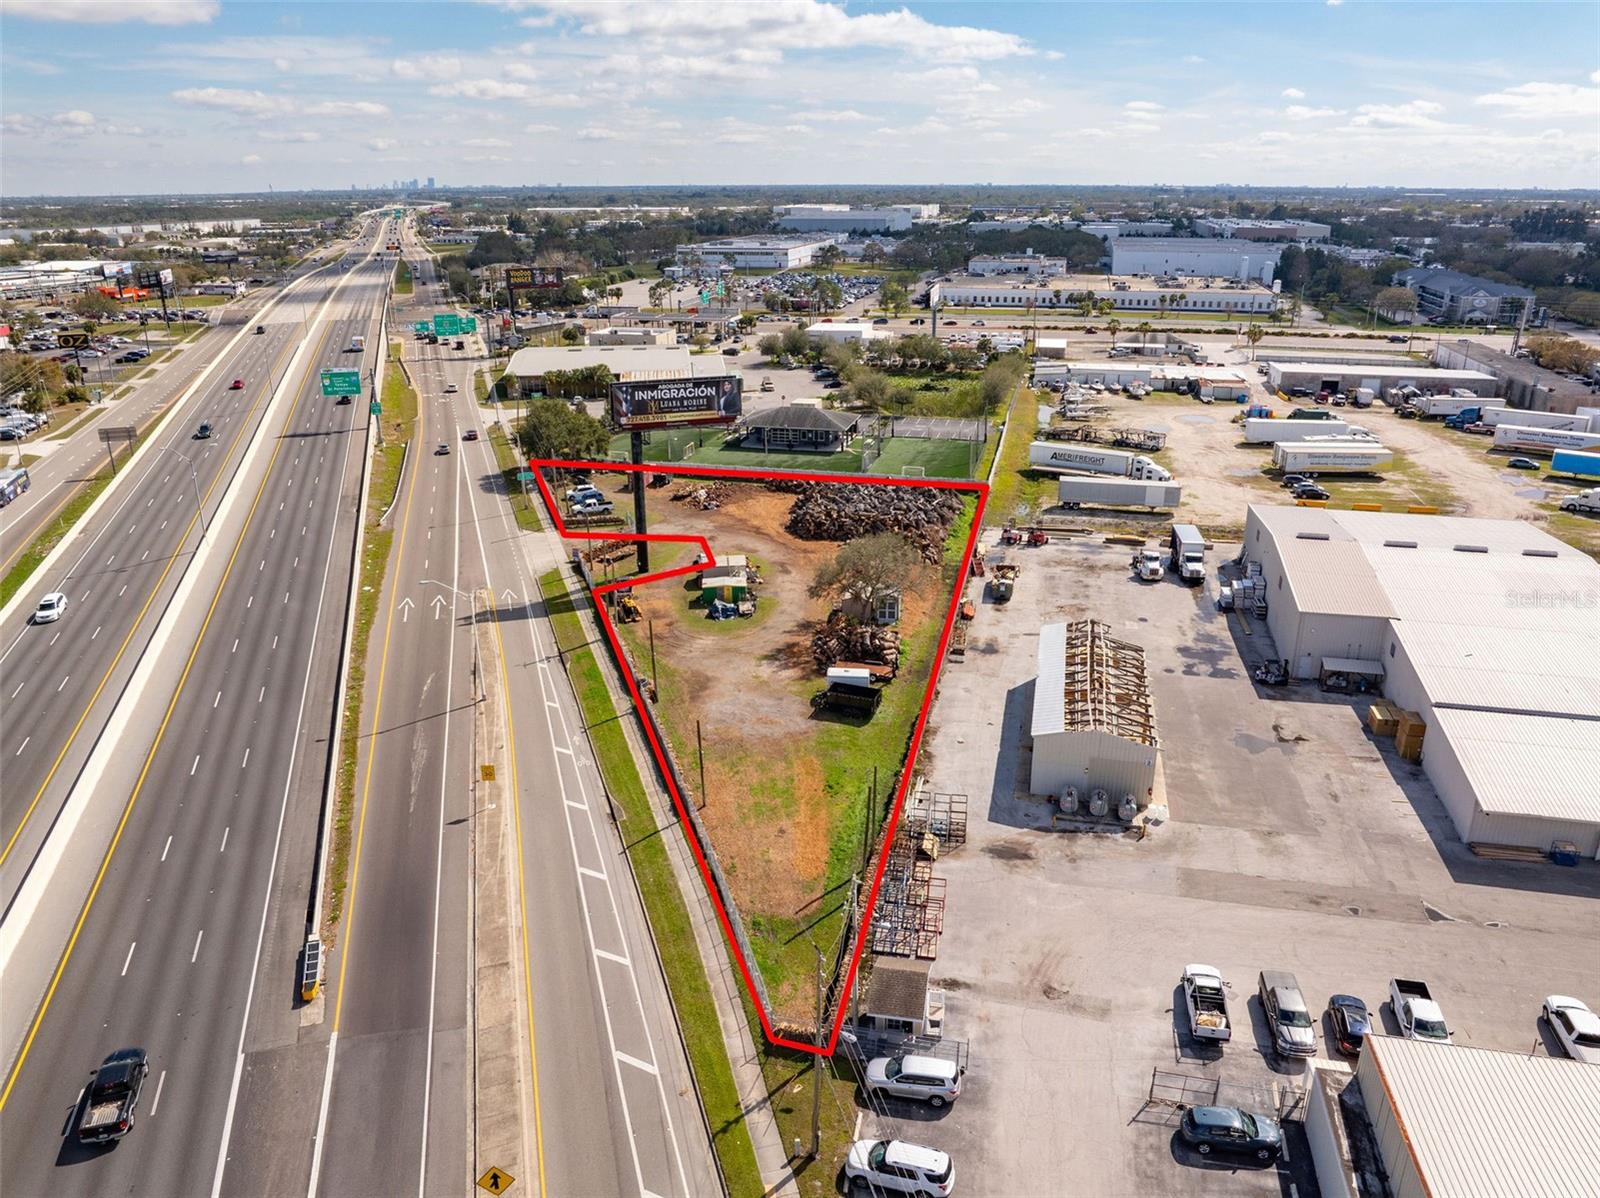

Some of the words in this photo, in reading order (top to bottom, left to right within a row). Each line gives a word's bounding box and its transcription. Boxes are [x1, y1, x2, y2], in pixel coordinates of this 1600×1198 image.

[60, 335, 87, 347] OZ
[635, 385, 716, 400] INMIGRACIÓN
[1050, 452, 1105, 464] AMERIFREIGHT
